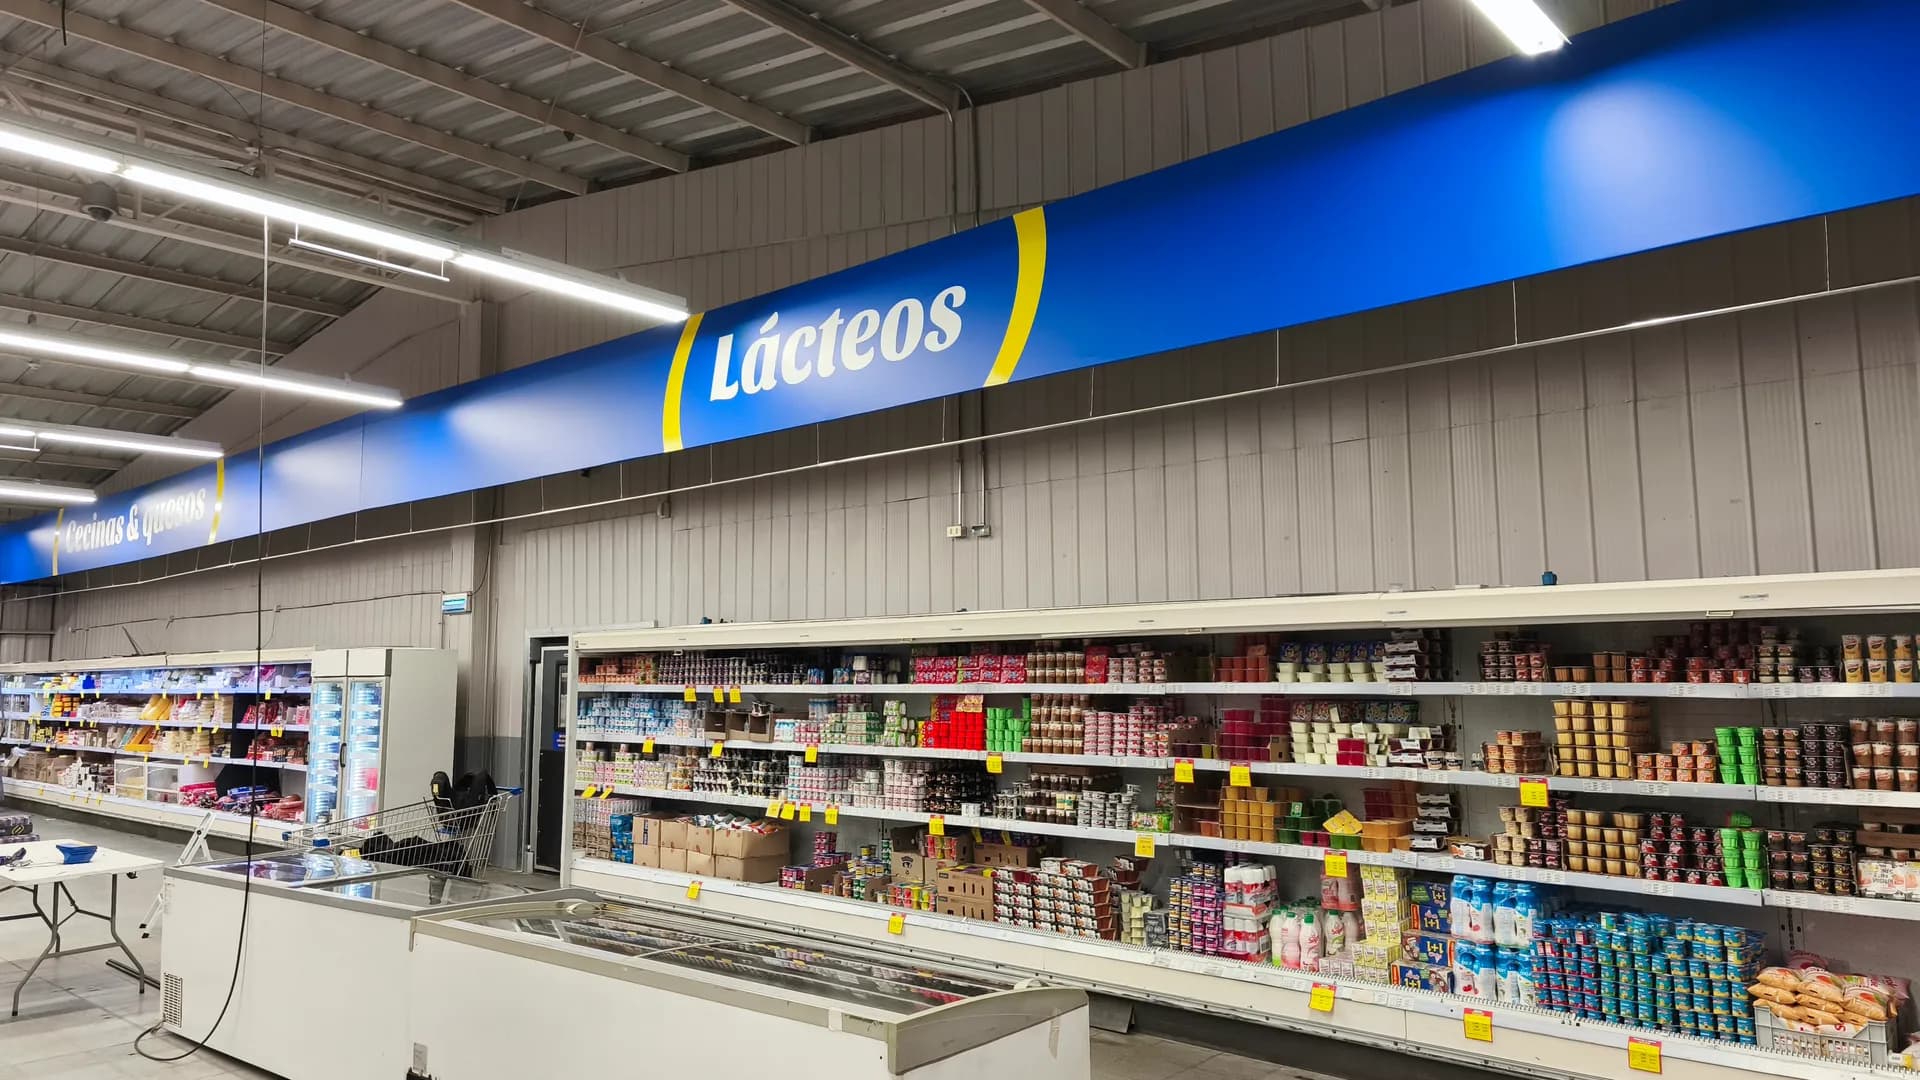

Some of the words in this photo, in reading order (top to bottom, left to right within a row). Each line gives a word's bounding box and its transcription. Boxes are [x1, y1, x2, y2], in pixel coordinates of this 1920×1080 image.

[709, 284, 967, 402] Lácteos
[66, 513, 125, 553] Cecinas
[126, 504, 139, 541] &
[142, 488, 206, 545] quesos
[1424, 918, 1440, 930] 1+1
[1427, 941, 1443, 954] 1+1
